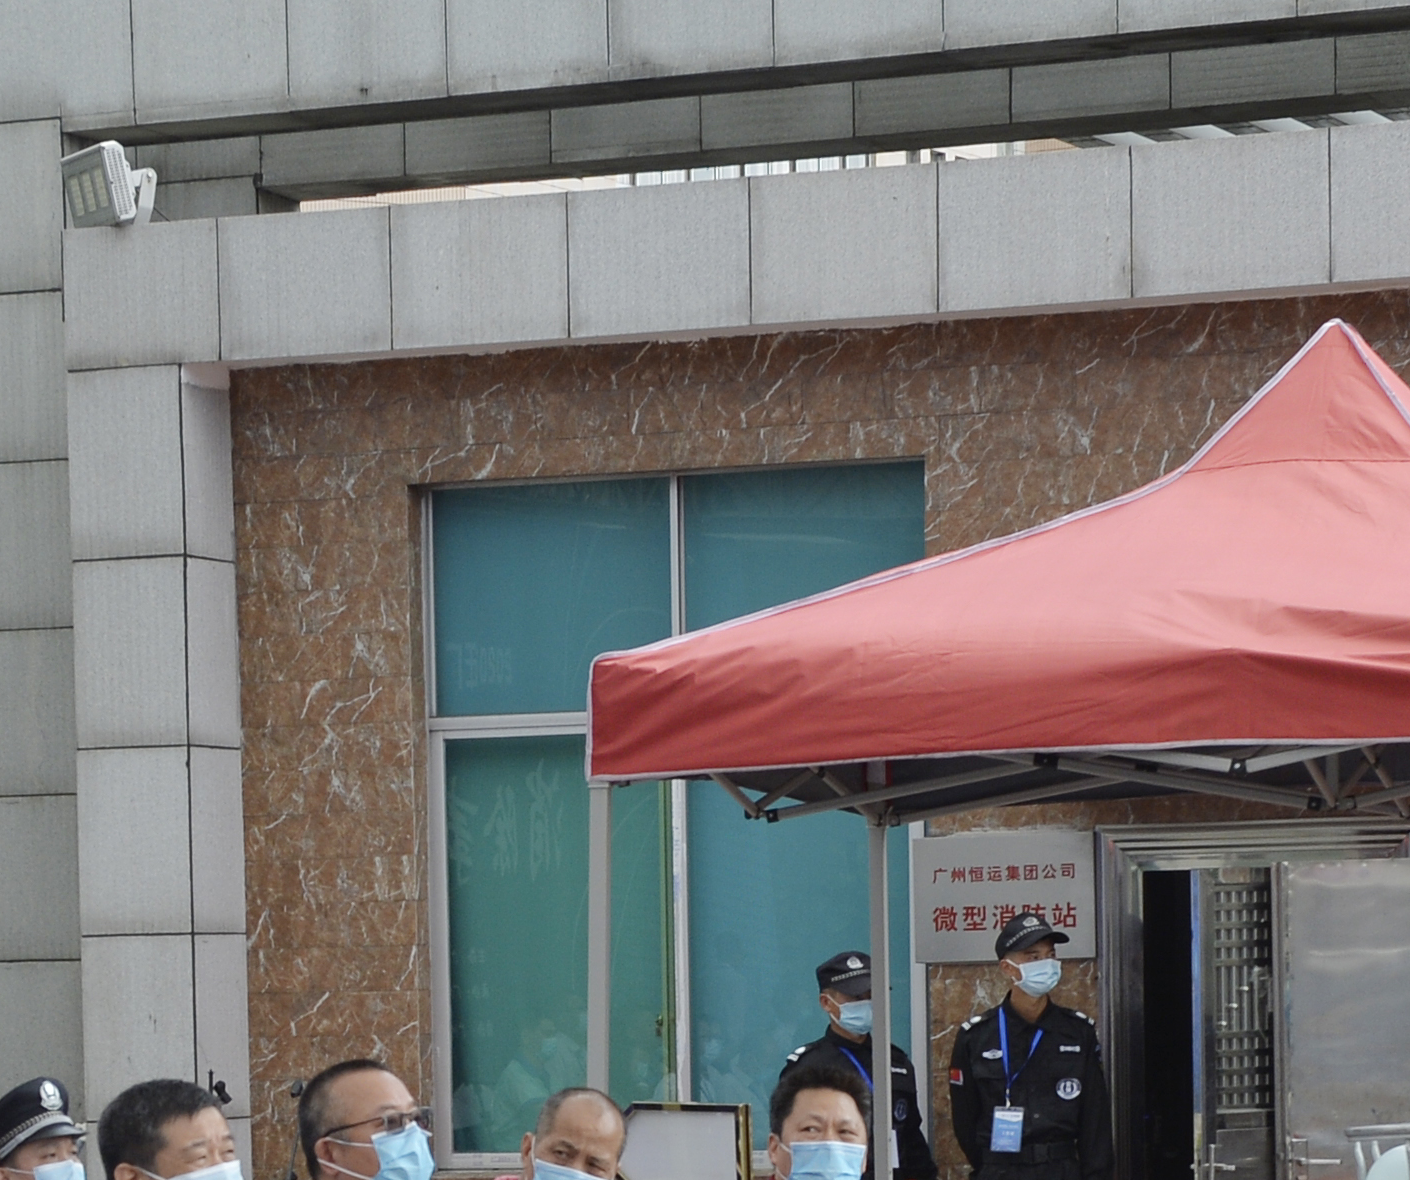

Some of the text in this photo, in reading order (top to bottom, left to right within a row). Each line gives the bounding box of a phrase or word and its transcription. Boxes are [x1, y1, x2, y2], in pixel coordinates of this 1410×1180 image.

[933, 863, 1076, 884] 广州恒运集团公司
